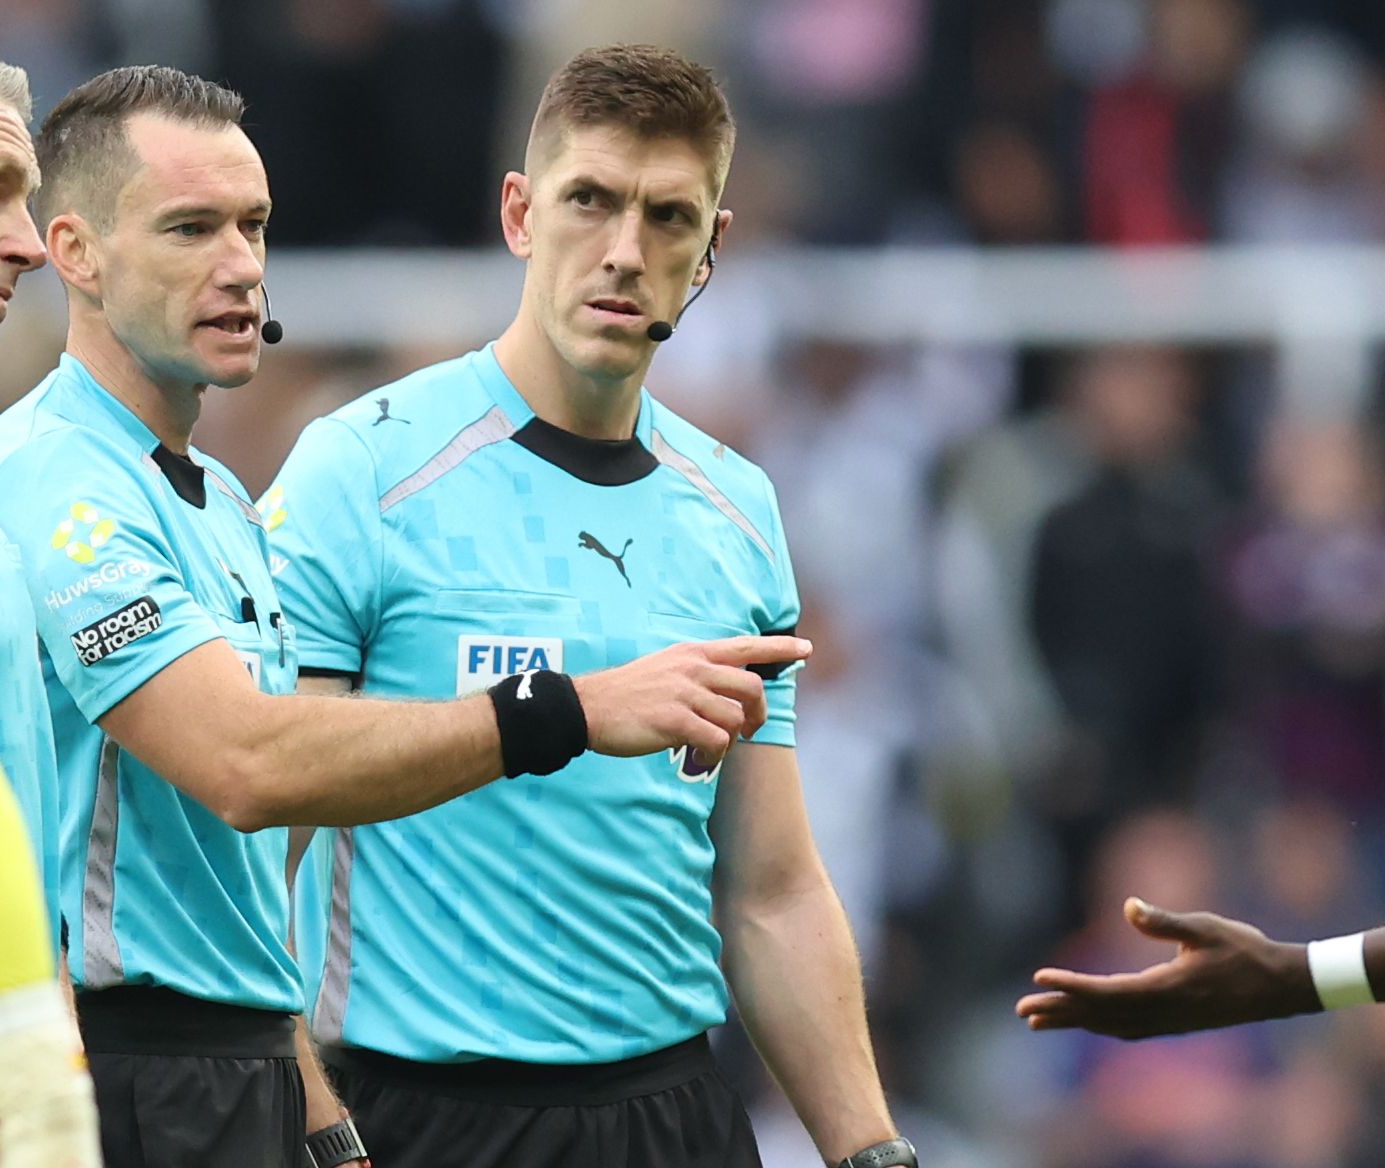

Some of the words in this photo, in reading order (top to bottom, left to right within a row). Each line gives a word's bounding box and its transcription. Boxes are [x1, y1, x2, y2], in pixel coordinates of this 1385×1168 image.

[71, 629, 99, 652] No
[98, 601, 152, 638] room
[77, 642, 104, 666] for
[104, 612, 162, 653] racism
[468, 645, 550, 674] FIFA
